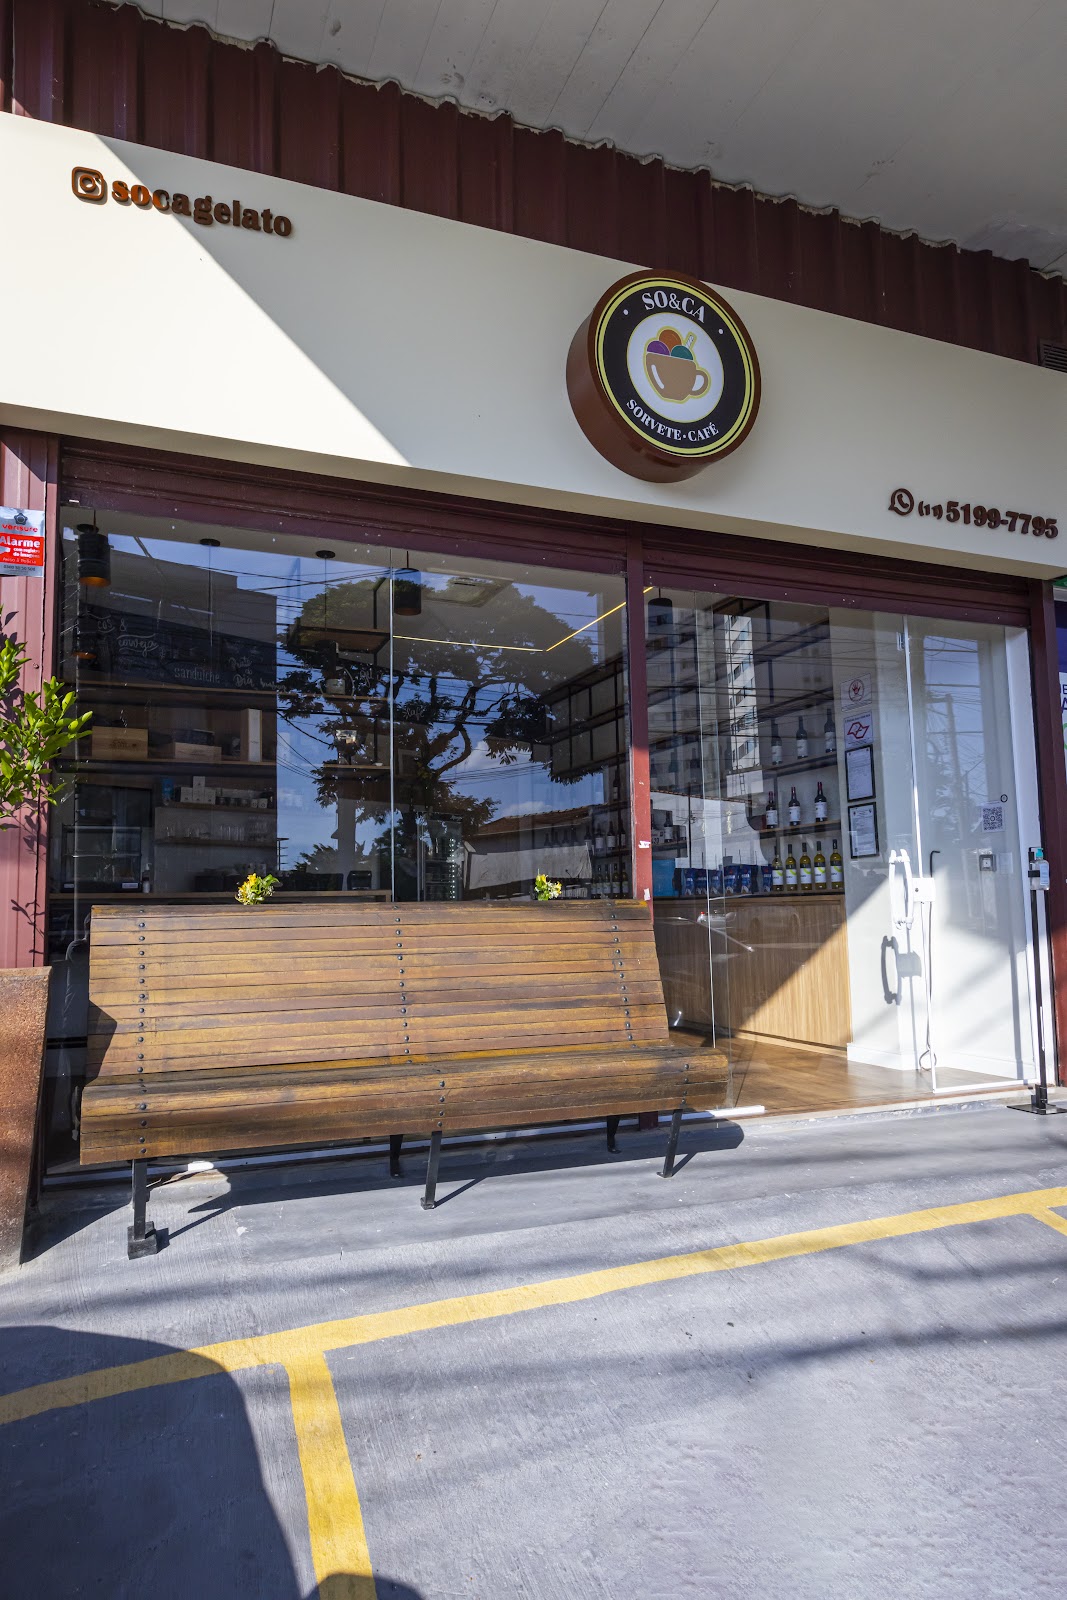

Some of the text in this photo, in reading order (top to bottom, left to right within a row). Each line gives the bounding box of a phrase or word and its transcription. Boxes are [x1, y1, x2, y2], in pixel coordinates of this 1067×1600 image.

[111, 180, 292, 237] socagelato
[641, 290, 705, 324] SO&CA
[2, 524, 38, 533] verisure
[946, 500, 1058, 539] 5199-7795
[0, 536, 40, 547] Alarme
